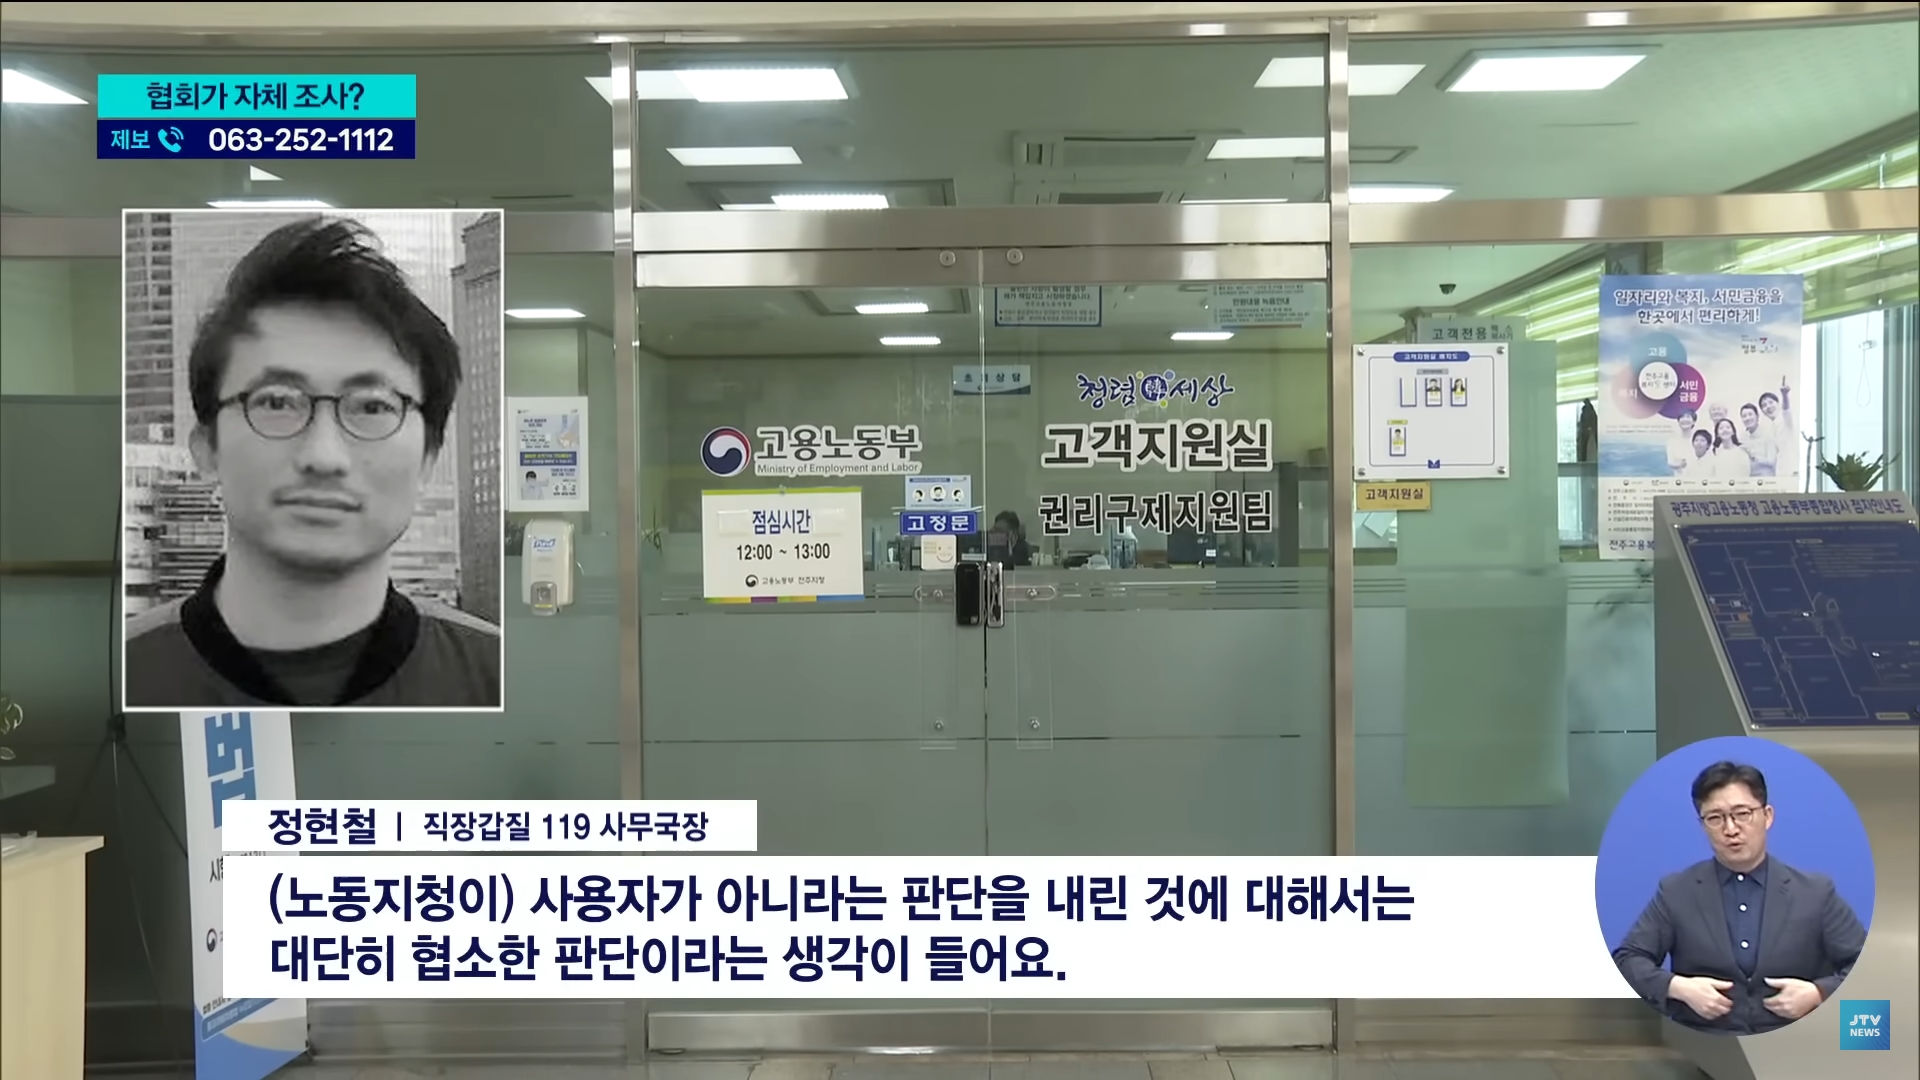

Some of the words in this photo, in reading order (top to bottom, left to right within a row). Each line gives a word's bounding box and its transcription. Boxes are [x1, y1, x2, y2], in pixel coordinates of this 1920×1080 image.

[1614, 289, 1672, 305] 일자리와
[1675, 289, 1709, 305] 복지,
[1714, 288, 1783, 304] 서민금융을
[1637, 309, 1694, 324] 한곳에서
[1699, 308, 1761, 323] 편리하게!
[1680, 380, 1699, 391] 서민
[756, 428, 919, 461] 고용노동부
[1043, 422, 1270, 469] 고객지원실
[757, 464, 795, 474] Ministry
[798, 463, 807, 472] of
[810, 463, 868, 475] Employment
[871, 463, 889, 472] and
[892, 462, 918, 472] Labor
[1365, 488, 1424, 501] 고객지원실
[1040, 492, 1271, 534] 권리구제지원팀
[752, 509, 811, 535] 점심시간
[907, 515, 969, 532] 고정문
[737, 544, 773, 560] 12:00
[794, 543, 830, 559] 13:00
